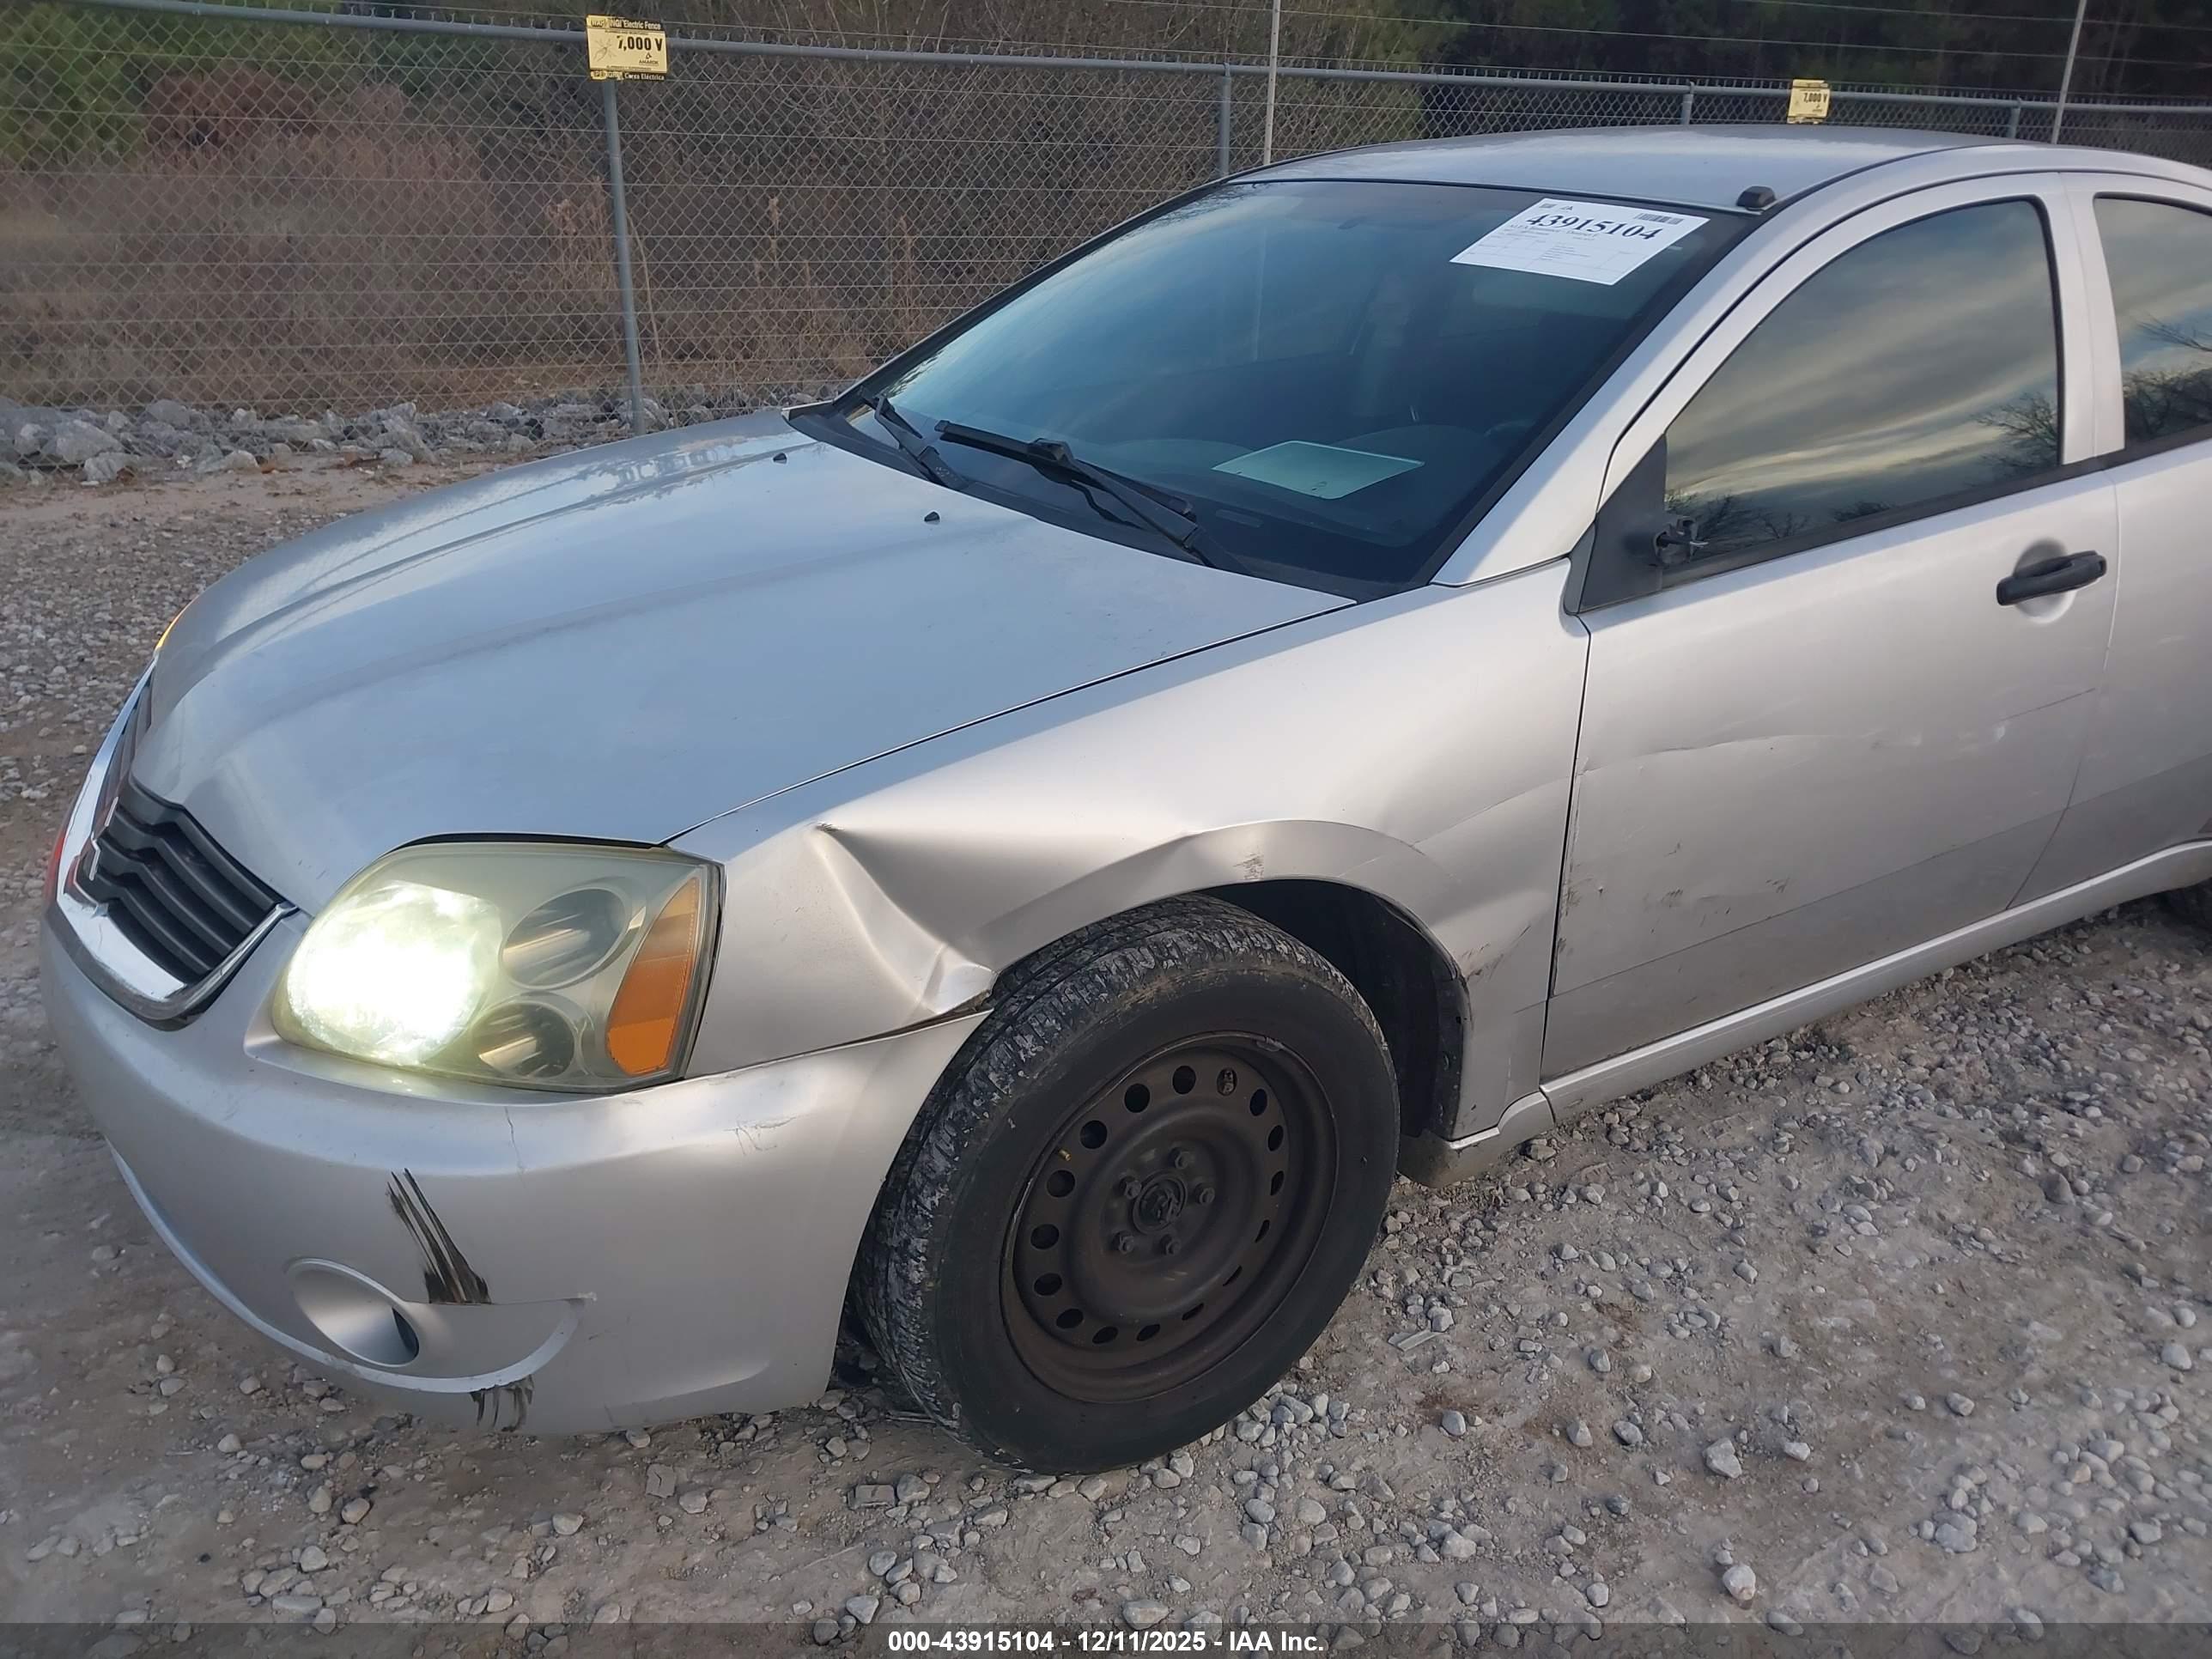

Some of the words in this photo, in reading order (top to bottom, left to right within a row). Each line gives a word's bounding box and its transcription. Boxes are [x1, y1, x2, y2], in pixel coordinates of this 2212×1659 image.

[623, 19, 644, 29] Electric
[645, 21, 661, 30] Fence
[617, 35, 652, 51] 7,000
[655, 38, 663, 51] V
[1823, 94, 1827, 102] V
[1526, 213, 1663, 240] 43915104
